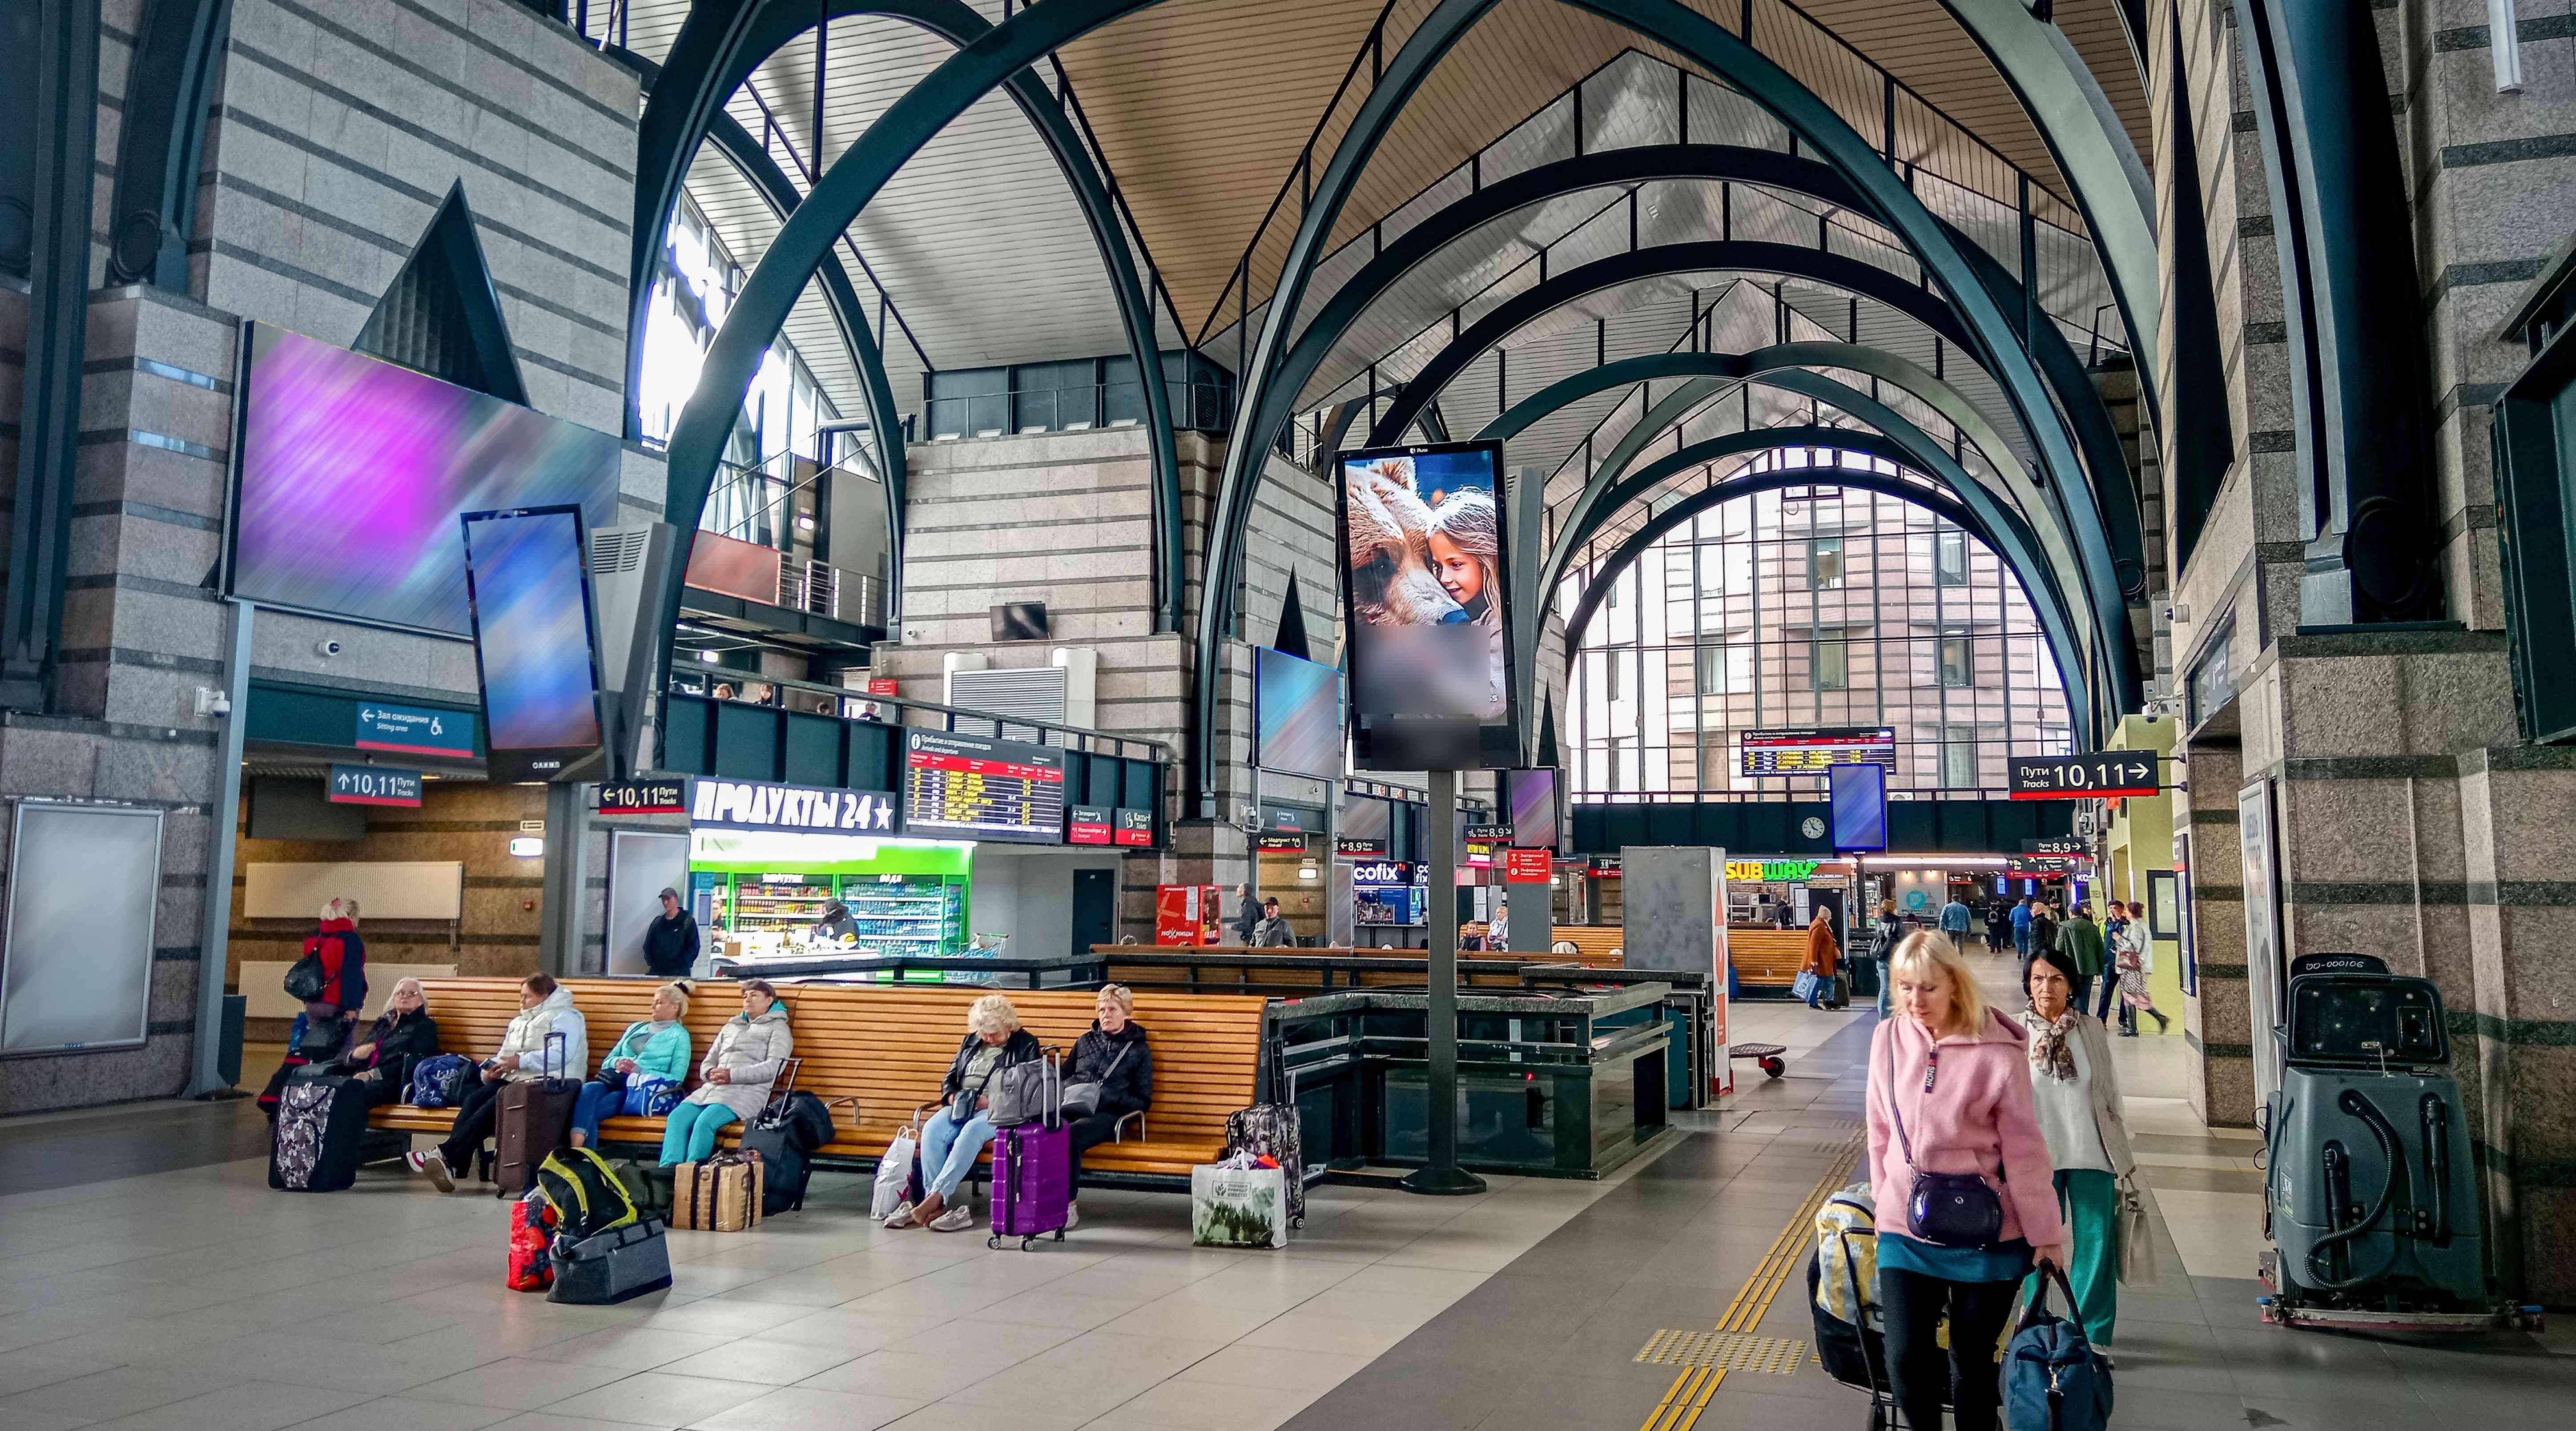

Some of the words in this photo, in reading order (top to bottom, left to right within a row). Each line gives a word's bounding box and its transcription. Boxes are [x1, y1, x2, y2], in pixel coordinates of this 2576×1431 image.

[377, 710, 390, 720] Зал
[392, 714, 429, 724] ожидания
[2020, 766, 2049, 778] Пути
[2054, 764, 2124, 790] 10,11
[353, 774, 396, 797] 10,11
[397, 777, 415, 788] Пути
[2022, 780, 2049, 788] Tracks
[617, 787, 658, 808] 10,11
[659, 787, 677, 797] Пути
[692, 781, 839, 828] ПРОДУКТЫ
[841, 793, 872, 830] 24
[1489, 828, 1504, 839] 8,9
[1348, 842, 1362, 852] 8,9
[2053, 843, 2070, 854] 8,9
[1353, 863, 1398, 880] cofix
[1726, 861, 1818, 880] SUBWAY
[1416, 873, 1428, 883] fix
[1926, 1066, 1935, 1087] SNOW
